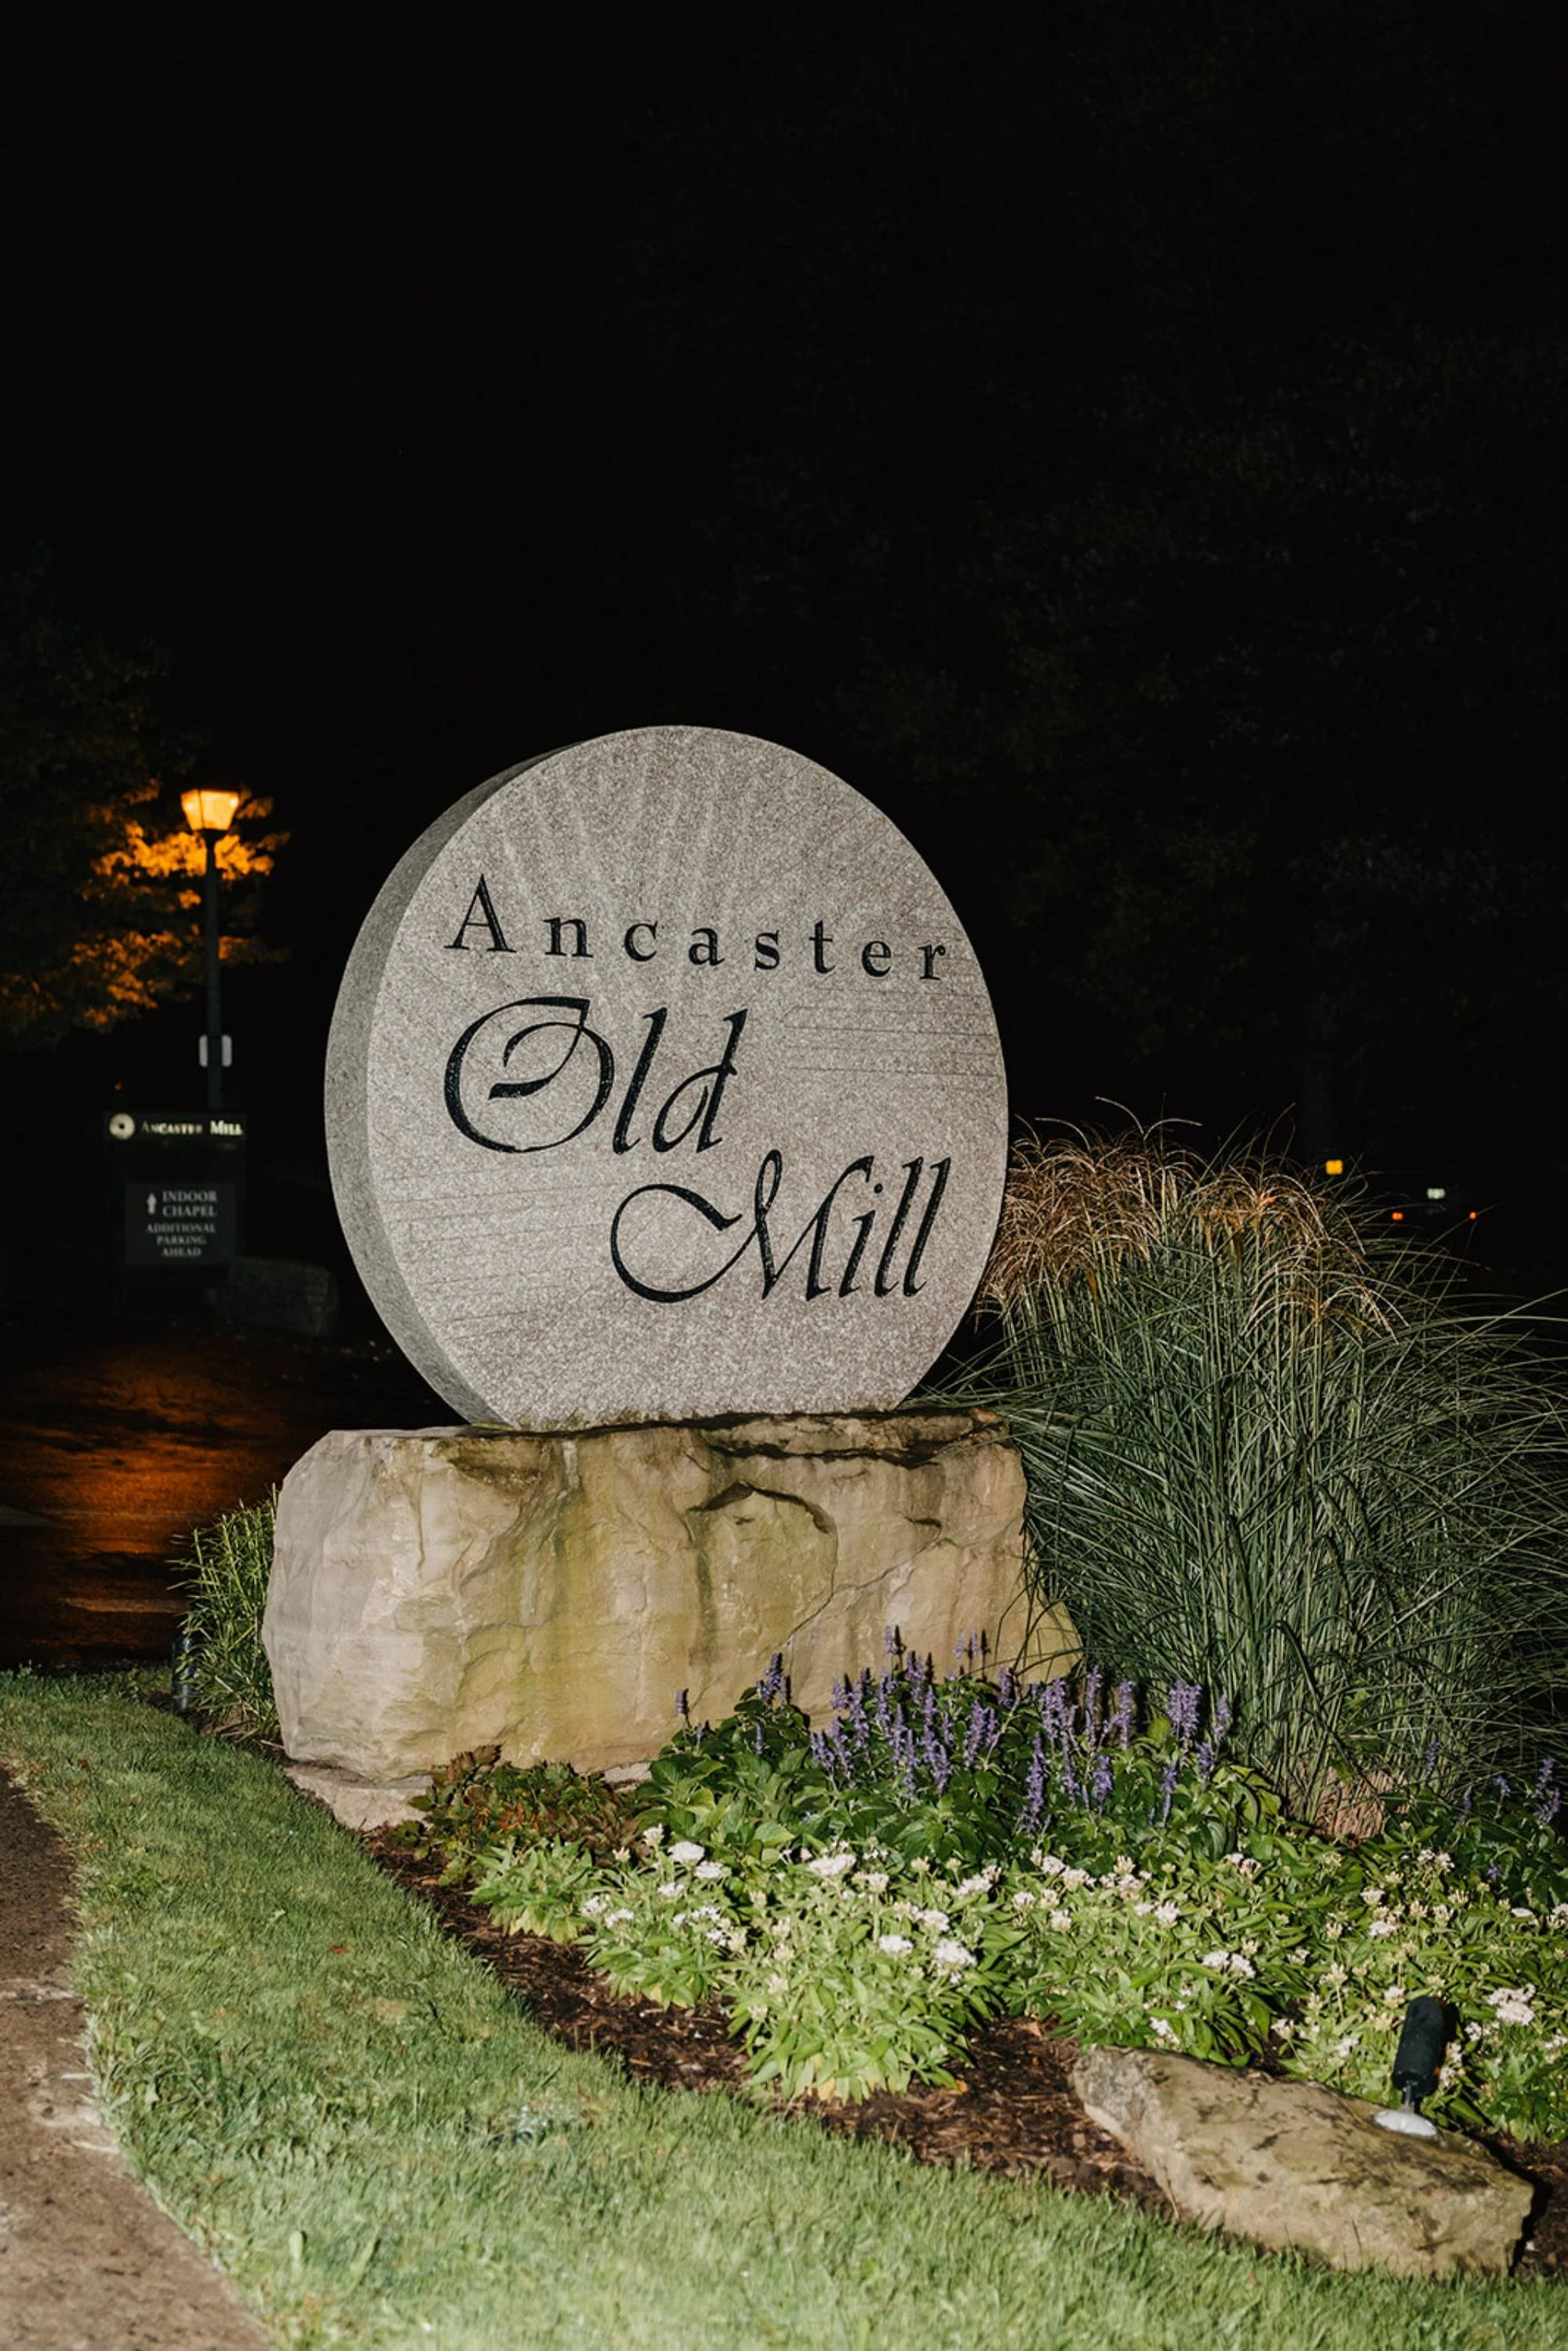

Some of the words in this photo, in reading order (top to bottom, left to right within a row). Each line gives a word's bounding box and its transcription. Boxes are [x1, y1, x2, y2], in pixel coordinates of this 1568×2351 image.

[444, 873, 946, 981] Ancaster
[444, 996, 749, 1154] Old
[162, 1190, 217, 1203] INDOOR
[162, 1205, 216, 1217] CHAPEL
[146, 1223, 216, 1234] ADDITIONAL
[611, 1149, 952, 1303] Mill
[157, 1235, 206, 1246] PARKING
[162, 1246, 201, 1257] AHEAD
